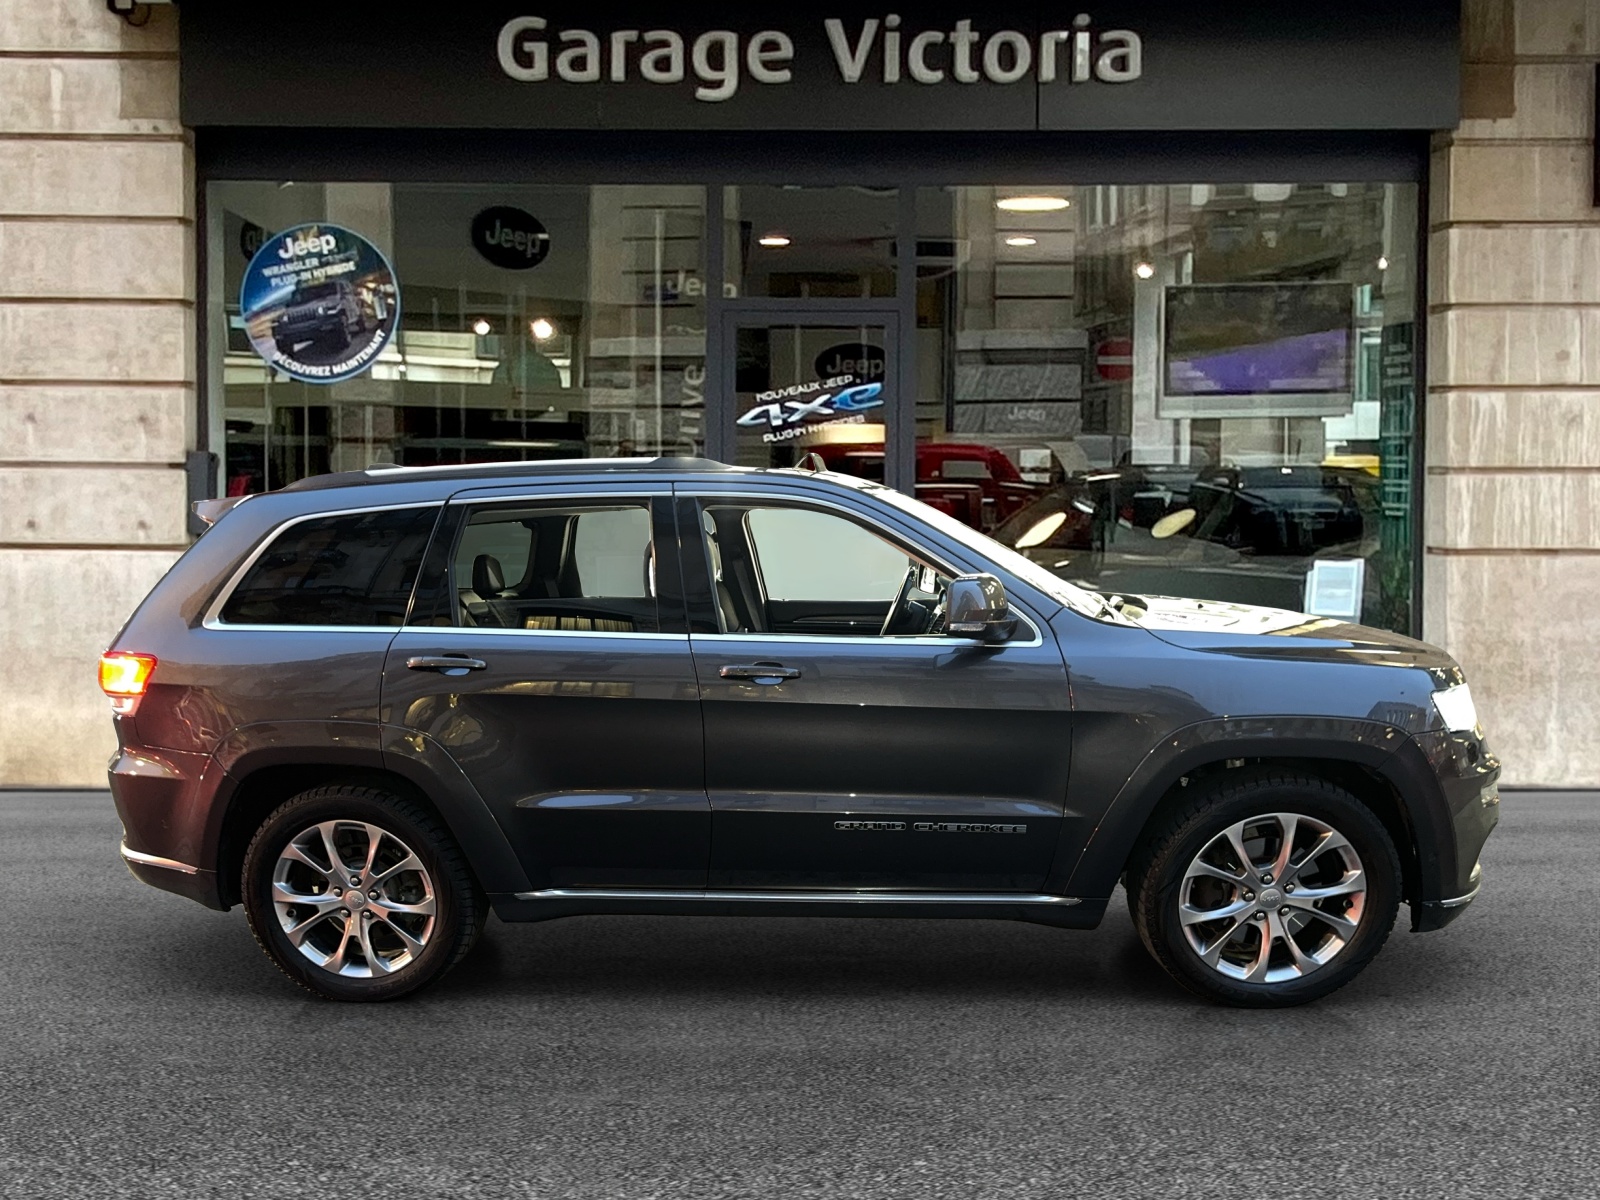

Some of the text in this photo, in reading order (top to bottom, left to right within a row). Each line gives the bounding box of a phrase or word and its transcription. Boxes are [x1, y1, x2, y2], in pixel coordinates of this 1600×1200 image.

[497, 13, 1142, 102] Garage Victoria
[278, 234, 336, 259] Jeep
[485, 219, 541, 258] Jeep
[262, 258, 319, 277] WRANGLER
[667, 269, 738, 298] Jep
[272, 328, 386, 376] DÉCOUVREZ MAINTENANT
[826, 353, 884, 379] Jeep
[756, 382, 821, 402] NOUVEAUX
[834, 820, 1028, 834] GRAND CHEROKEE
